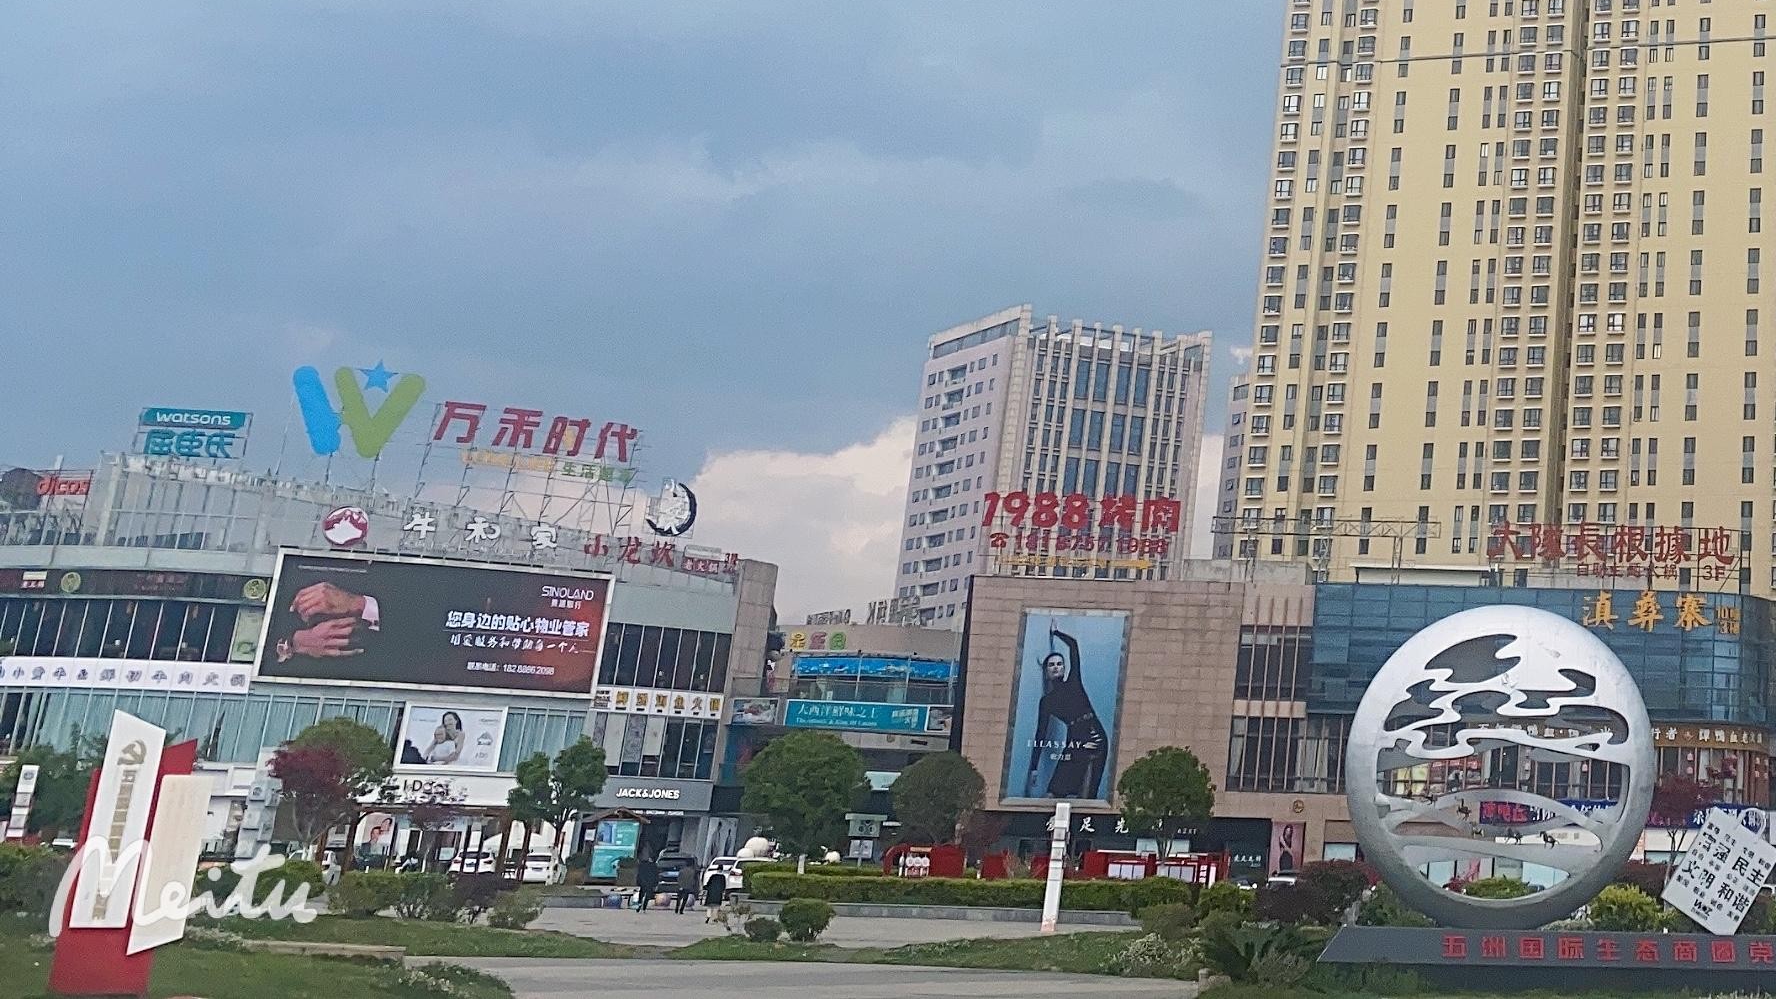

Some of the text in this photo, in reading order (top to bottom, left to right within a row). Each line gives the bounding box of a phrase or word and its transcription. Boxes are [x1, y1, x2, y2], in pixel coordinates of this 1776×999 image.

[155, 411, 232, 426] watsons
[433, 401, 638, 462] 万禾时代
[37, 477, 91, 495] dicos
[1703, 565, 1726, 582] 3F
[541, 585, 595, 601] SINOLAND
[445, 610, 590, 638] 您身边的贴心物业管家
[1027, 740, 1082, 749] ELLASSAY
[615, 787, 681, 801] JACK&JONES
[1732, 856, 1765, 888] 民主
[1717, 881, 1751, 913] 和谐
